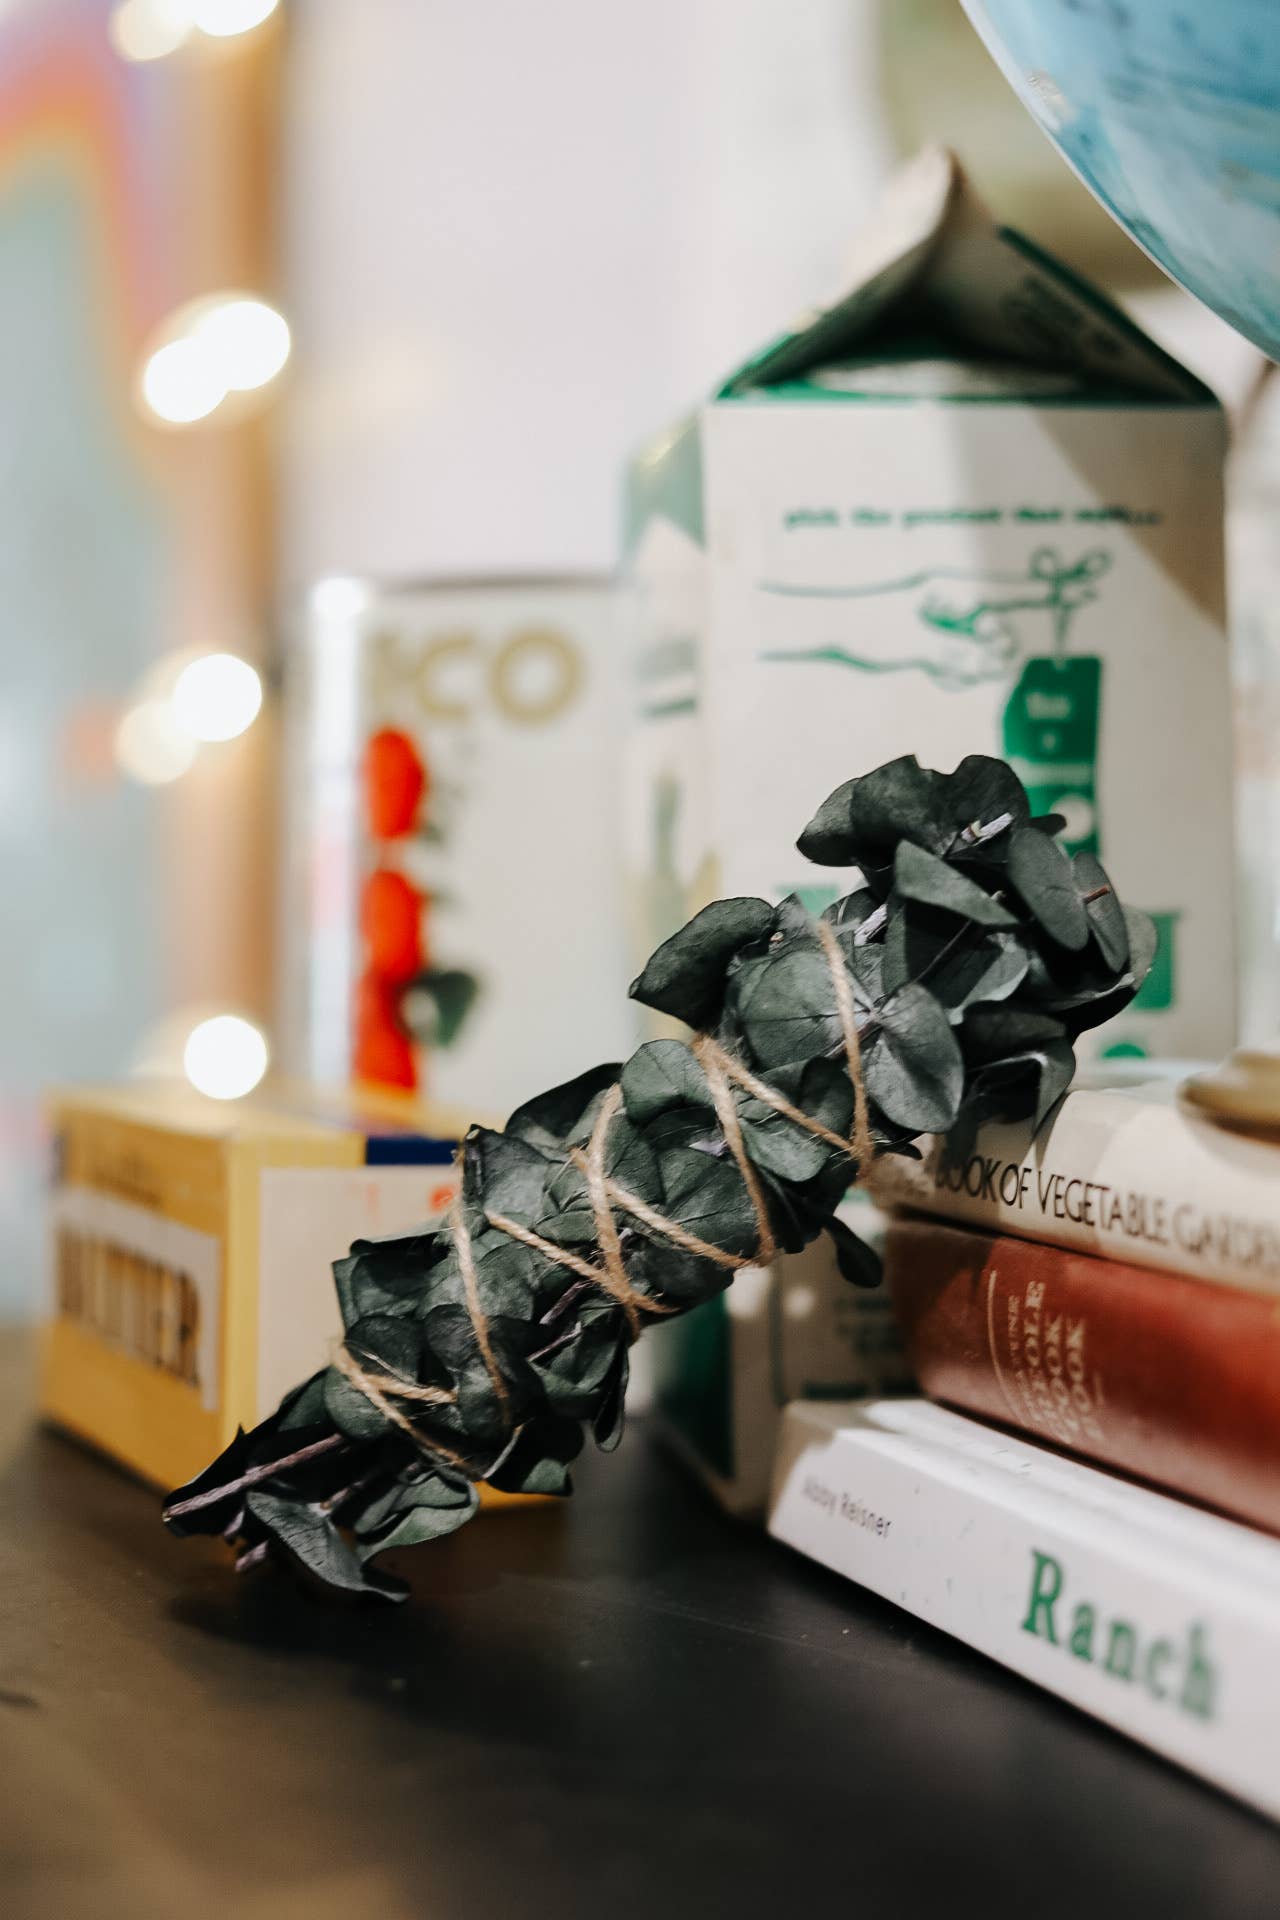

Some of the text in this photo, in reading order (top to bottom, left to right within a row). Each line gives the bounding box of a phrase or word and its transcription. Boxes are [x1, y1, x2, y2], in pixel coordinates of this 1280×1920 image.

[1000, 1162, 1032, 1211] OF
[1037, 1169, 1170, 1246] VEGETABLE
[1020, 1546, 1218, 1724] Ranch
